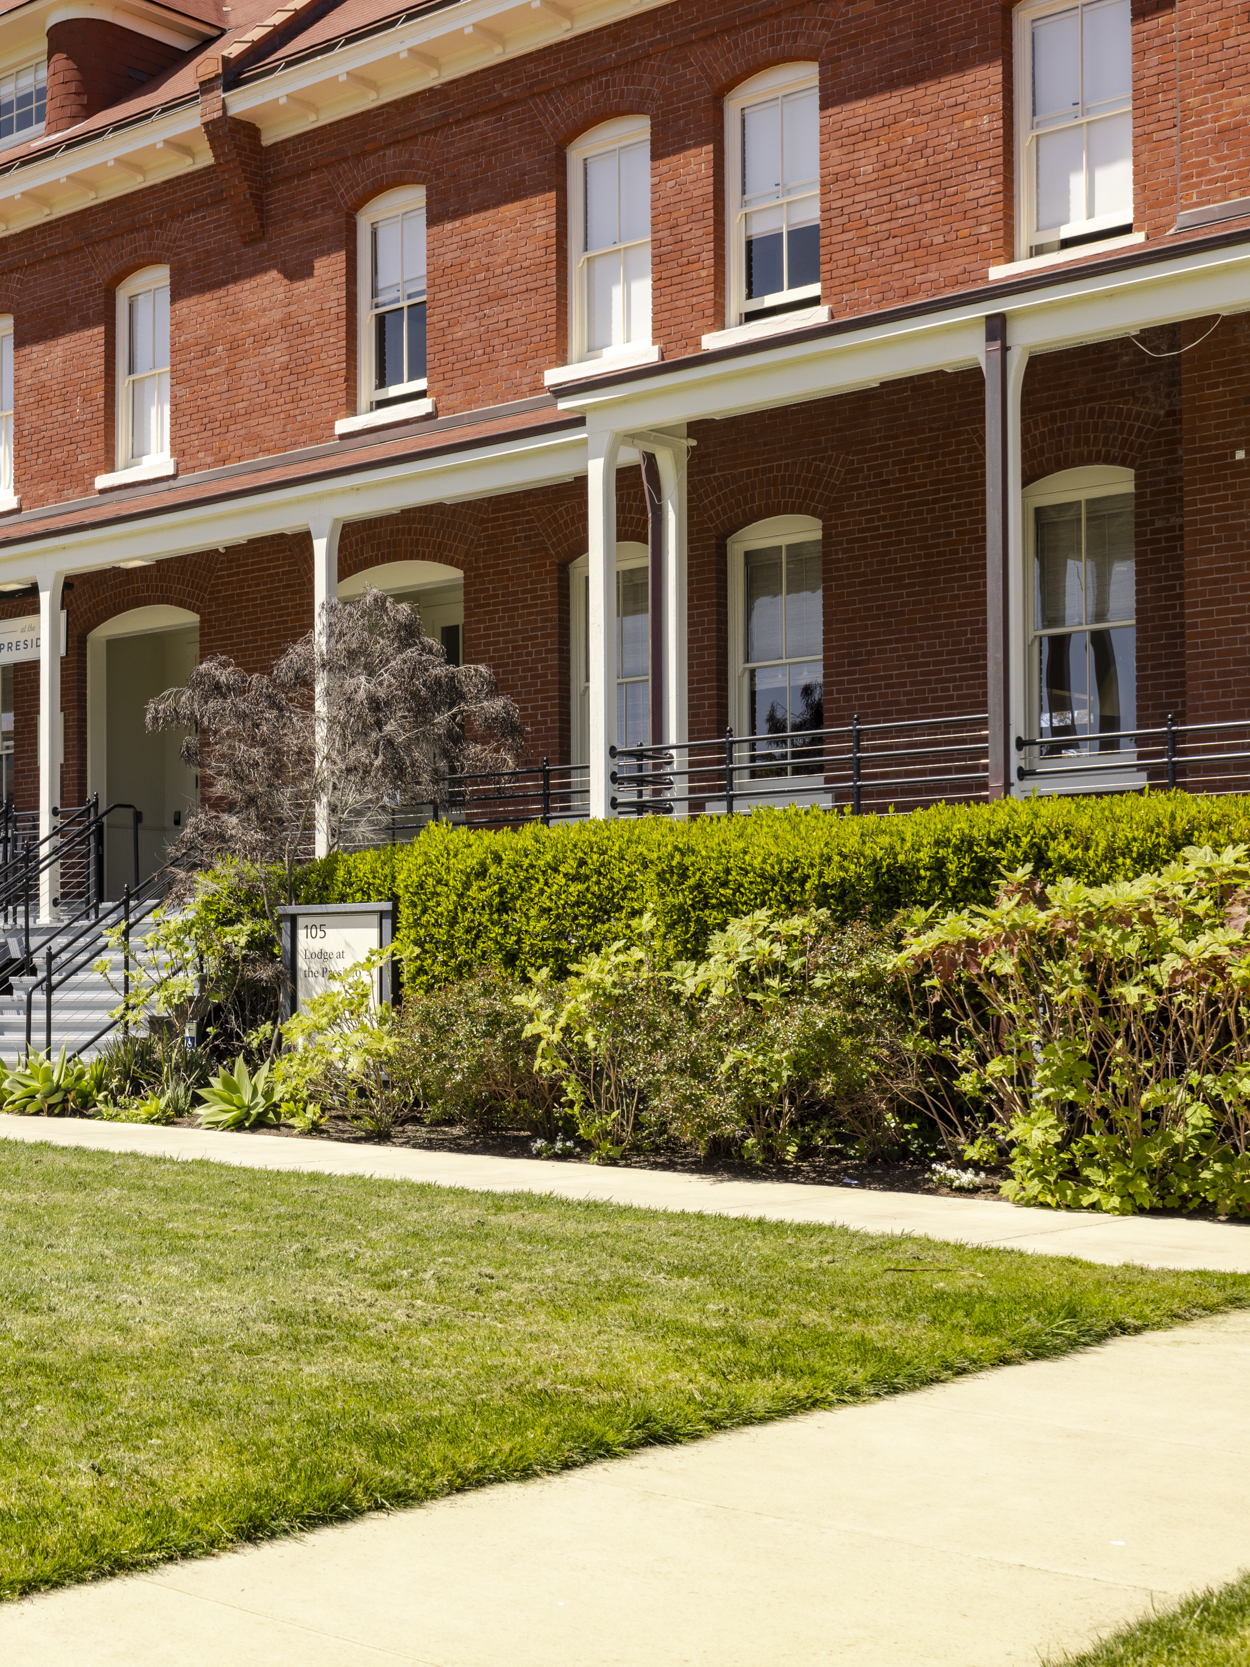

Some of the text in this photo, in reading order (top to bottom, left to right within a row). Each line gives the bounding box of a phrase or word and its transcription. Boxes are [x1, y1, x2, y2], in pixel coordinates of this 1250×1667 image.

[304, 924, 327, 939] 105
[304, 948, 345, 962] Lodge at
[303, 966, 319, 978] the
